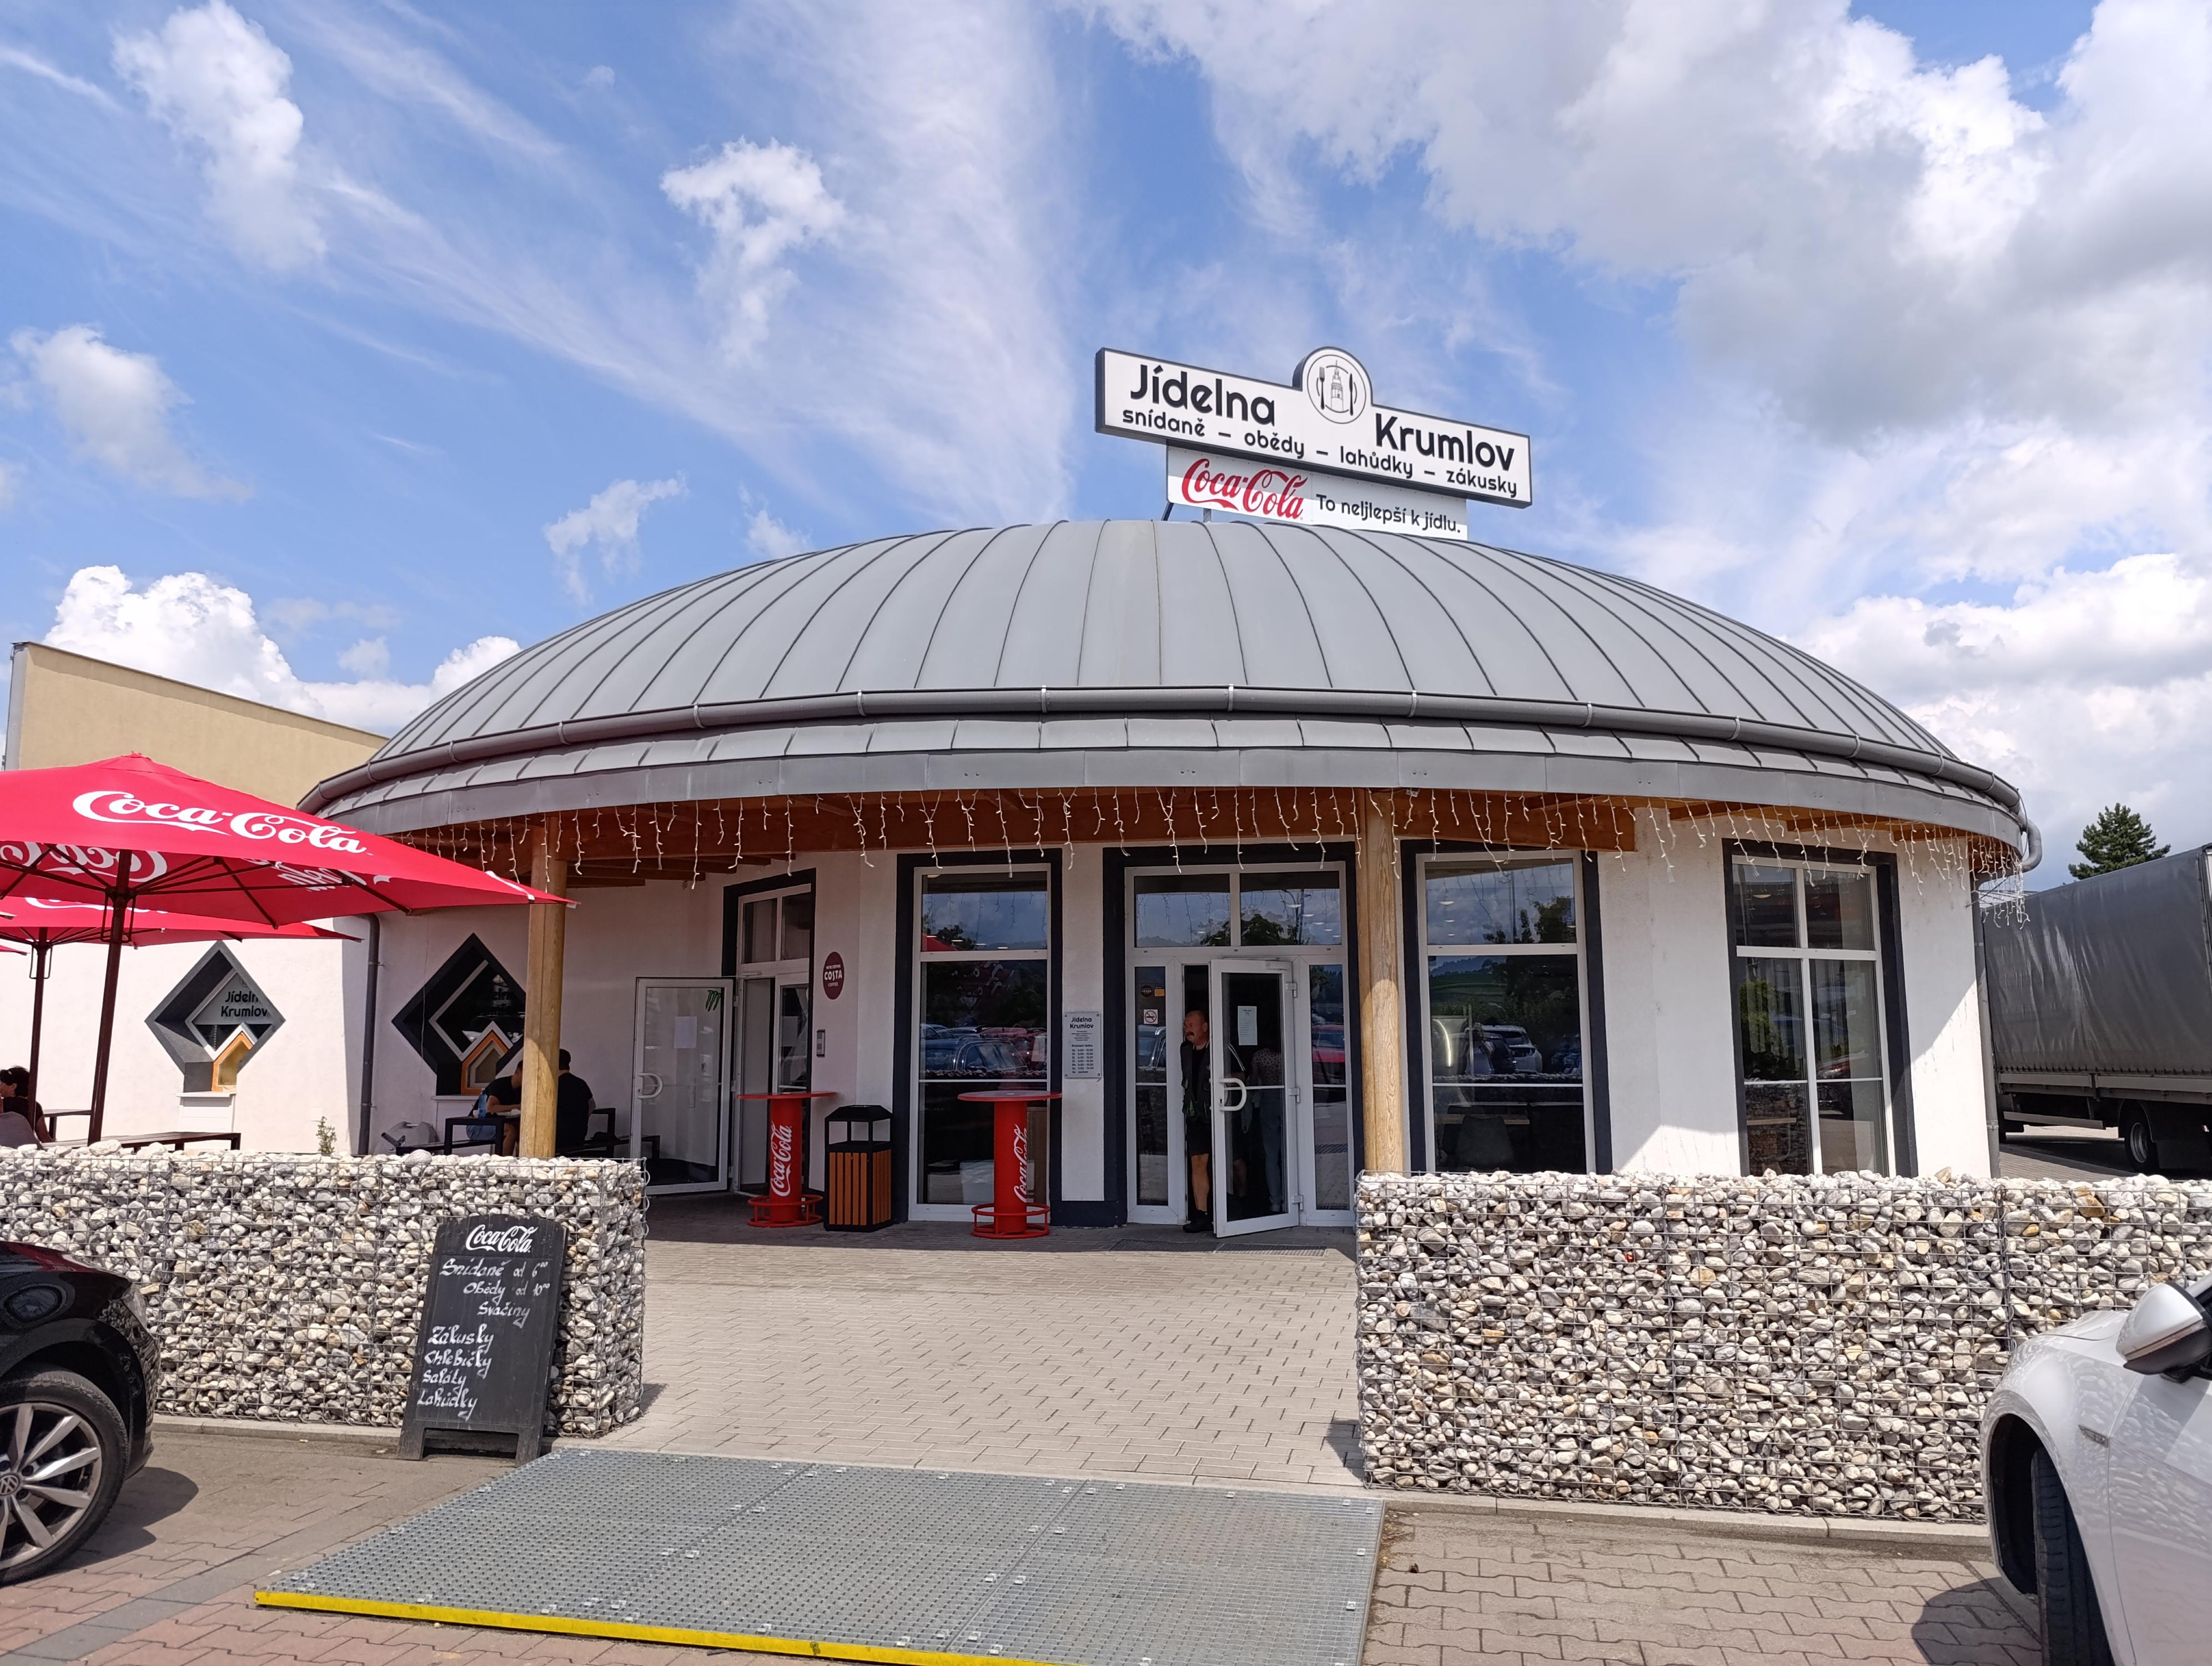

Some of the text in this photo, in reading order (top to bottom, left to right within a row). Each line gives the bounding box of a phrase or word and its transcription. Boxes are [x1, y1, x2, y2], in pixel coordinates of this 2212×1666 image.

[1130, 364, 1515, 471] Jídelna Krumlov
[1122, 408, 1205, 437] snídaně
[1244, 429, 1305, 459] obědy
[1340, 445, 1413, 479] lahůdky
[1446, 468, 1517, 498] zákusky
[1181, 458, 1309, 519] Coca-Cola
[1315, 494, 1336, 511] To
[1411, 509, 1420, 526] k
[1421, 511, 1461, 534] jídlu.
[72, 790, 368, 854] Coca-Cola
[824, 969, 843, 981] COSTA
[220, 1005, 268, 1017] Krumlov
[225, 990, 259, 1003] Jídeln
[770, 1120, 793, 1197] Coca-Cola
[465, 1224, 539, 1253] Coca-Cola
[439, 1257, 512, 1277] Snídaně
[513, 1261, 527, 1277] od
[463, 1279, 506, 1307] Obědy
[515, 1280, 529, 1296] od
[477, 1301, 531, 1329] Svačiny
[428, 1323, 495, 1355] Zákusky
[422, 1367, 467, 1396] Saláty
